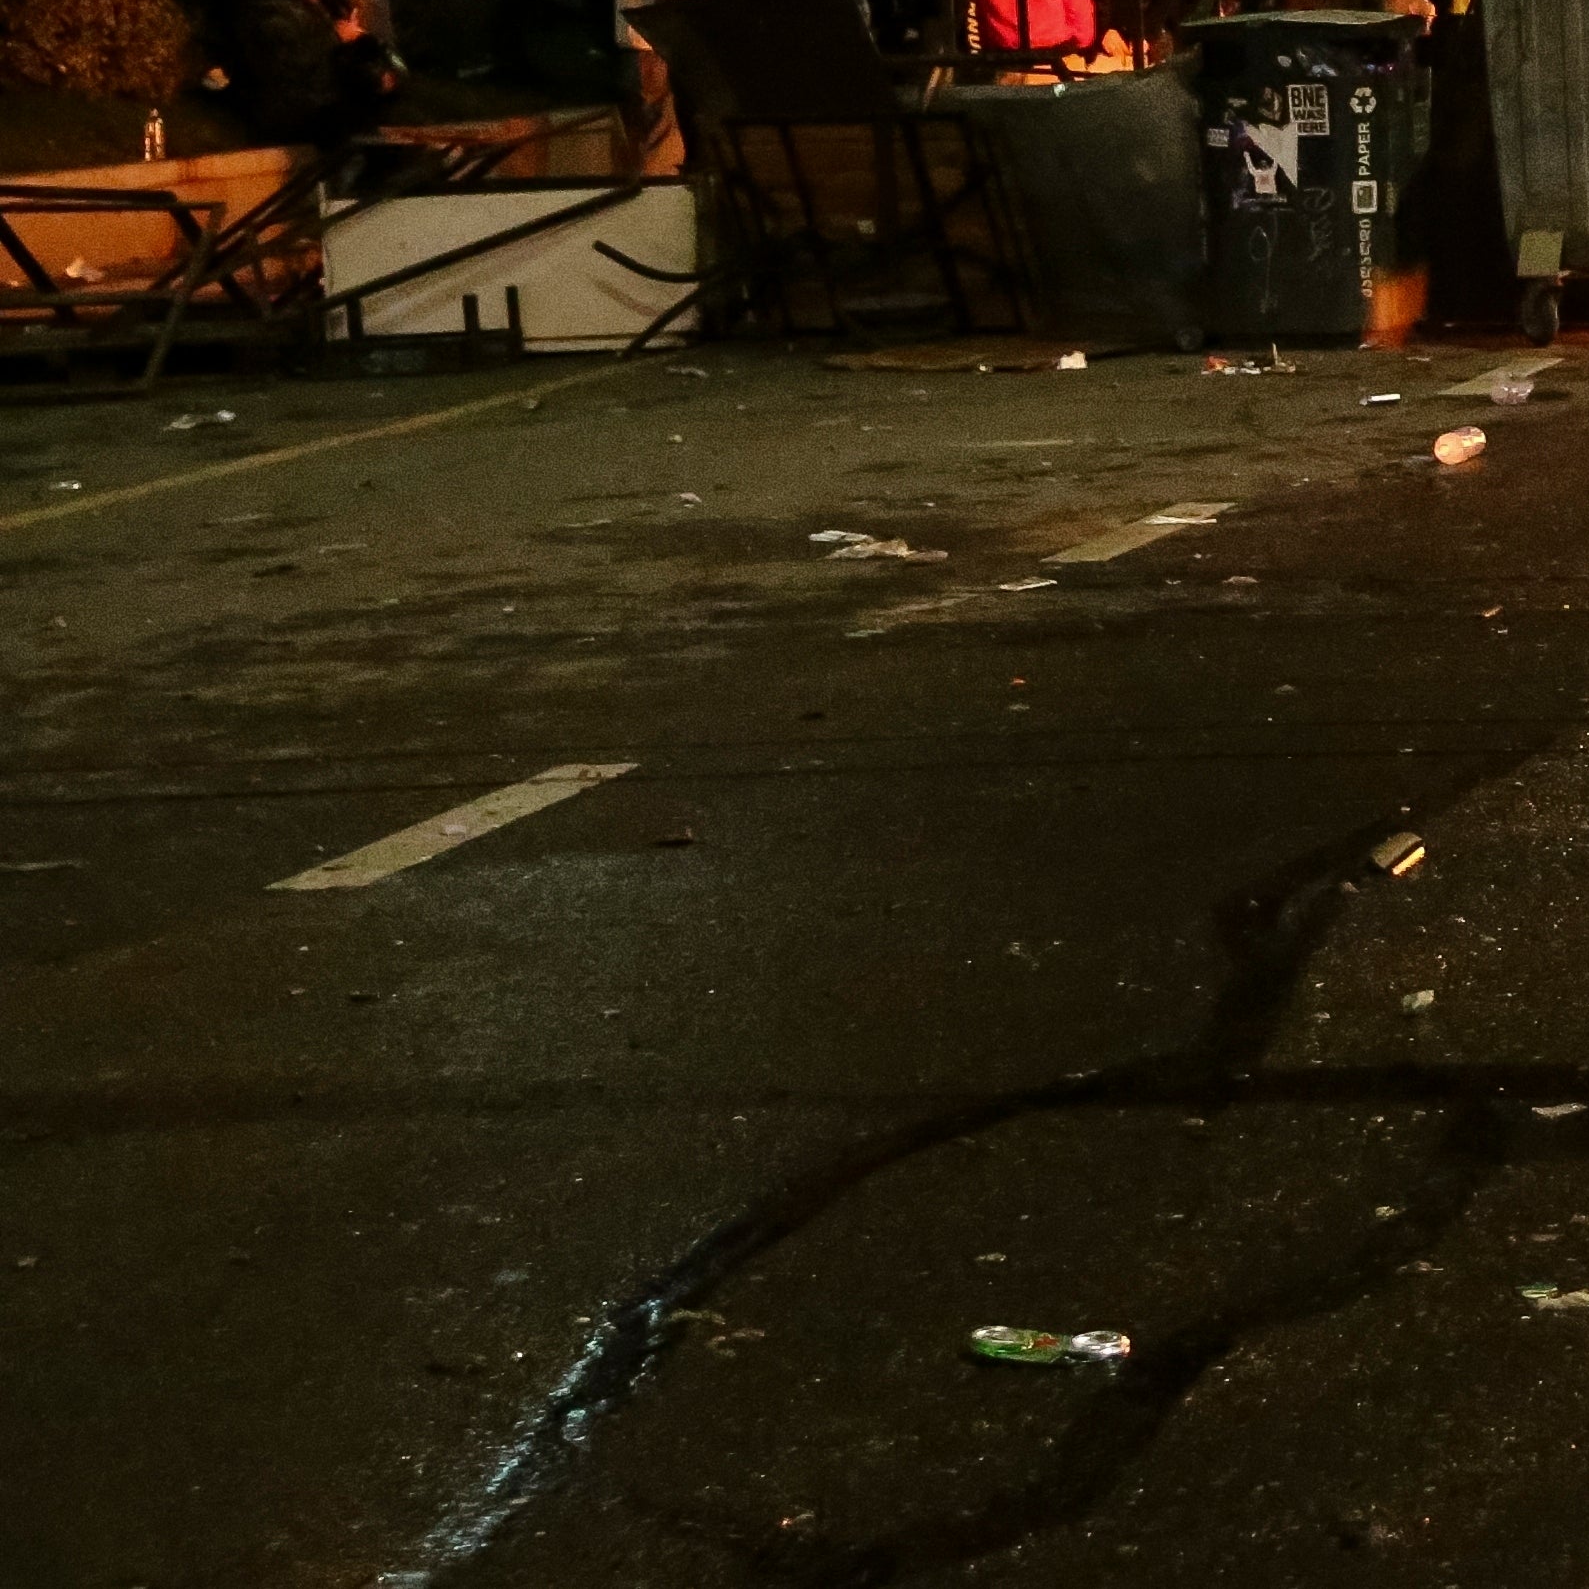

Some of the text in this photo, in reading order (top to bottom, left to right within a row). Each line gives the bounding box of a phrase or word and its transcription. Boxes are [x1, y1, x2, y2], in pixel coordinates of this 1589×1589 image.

[1291, 87, 1326, 108] BNE
[1294, 109, 1326, 121] WAS
[1358, 122, 1371, 176] PAPER
